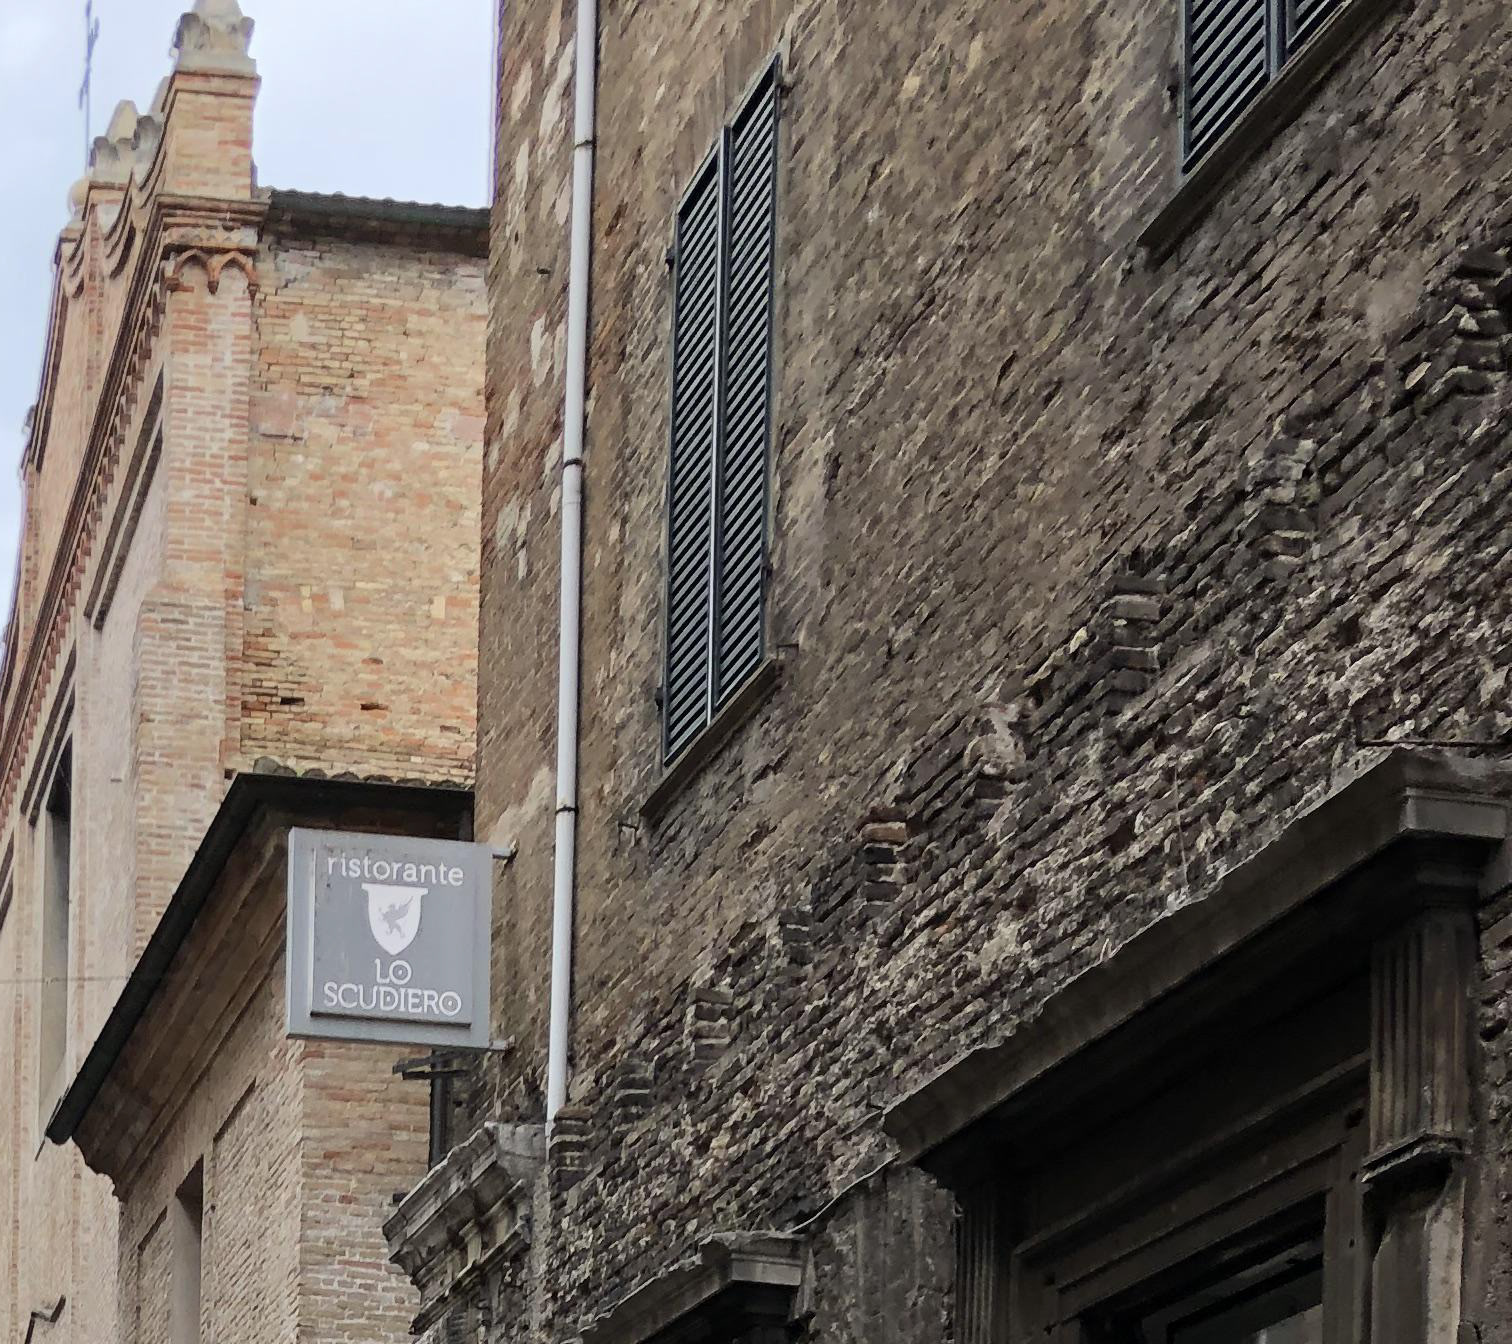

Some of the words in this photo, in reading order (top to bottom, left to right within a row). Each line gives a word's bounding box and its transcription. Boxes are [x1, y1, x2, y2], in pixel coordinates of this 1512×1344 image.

[326, 853, 464, 886] ristorante
[375, 958, 412, 984] LO
[323, 982, 462, 1016] SCUDIERO
